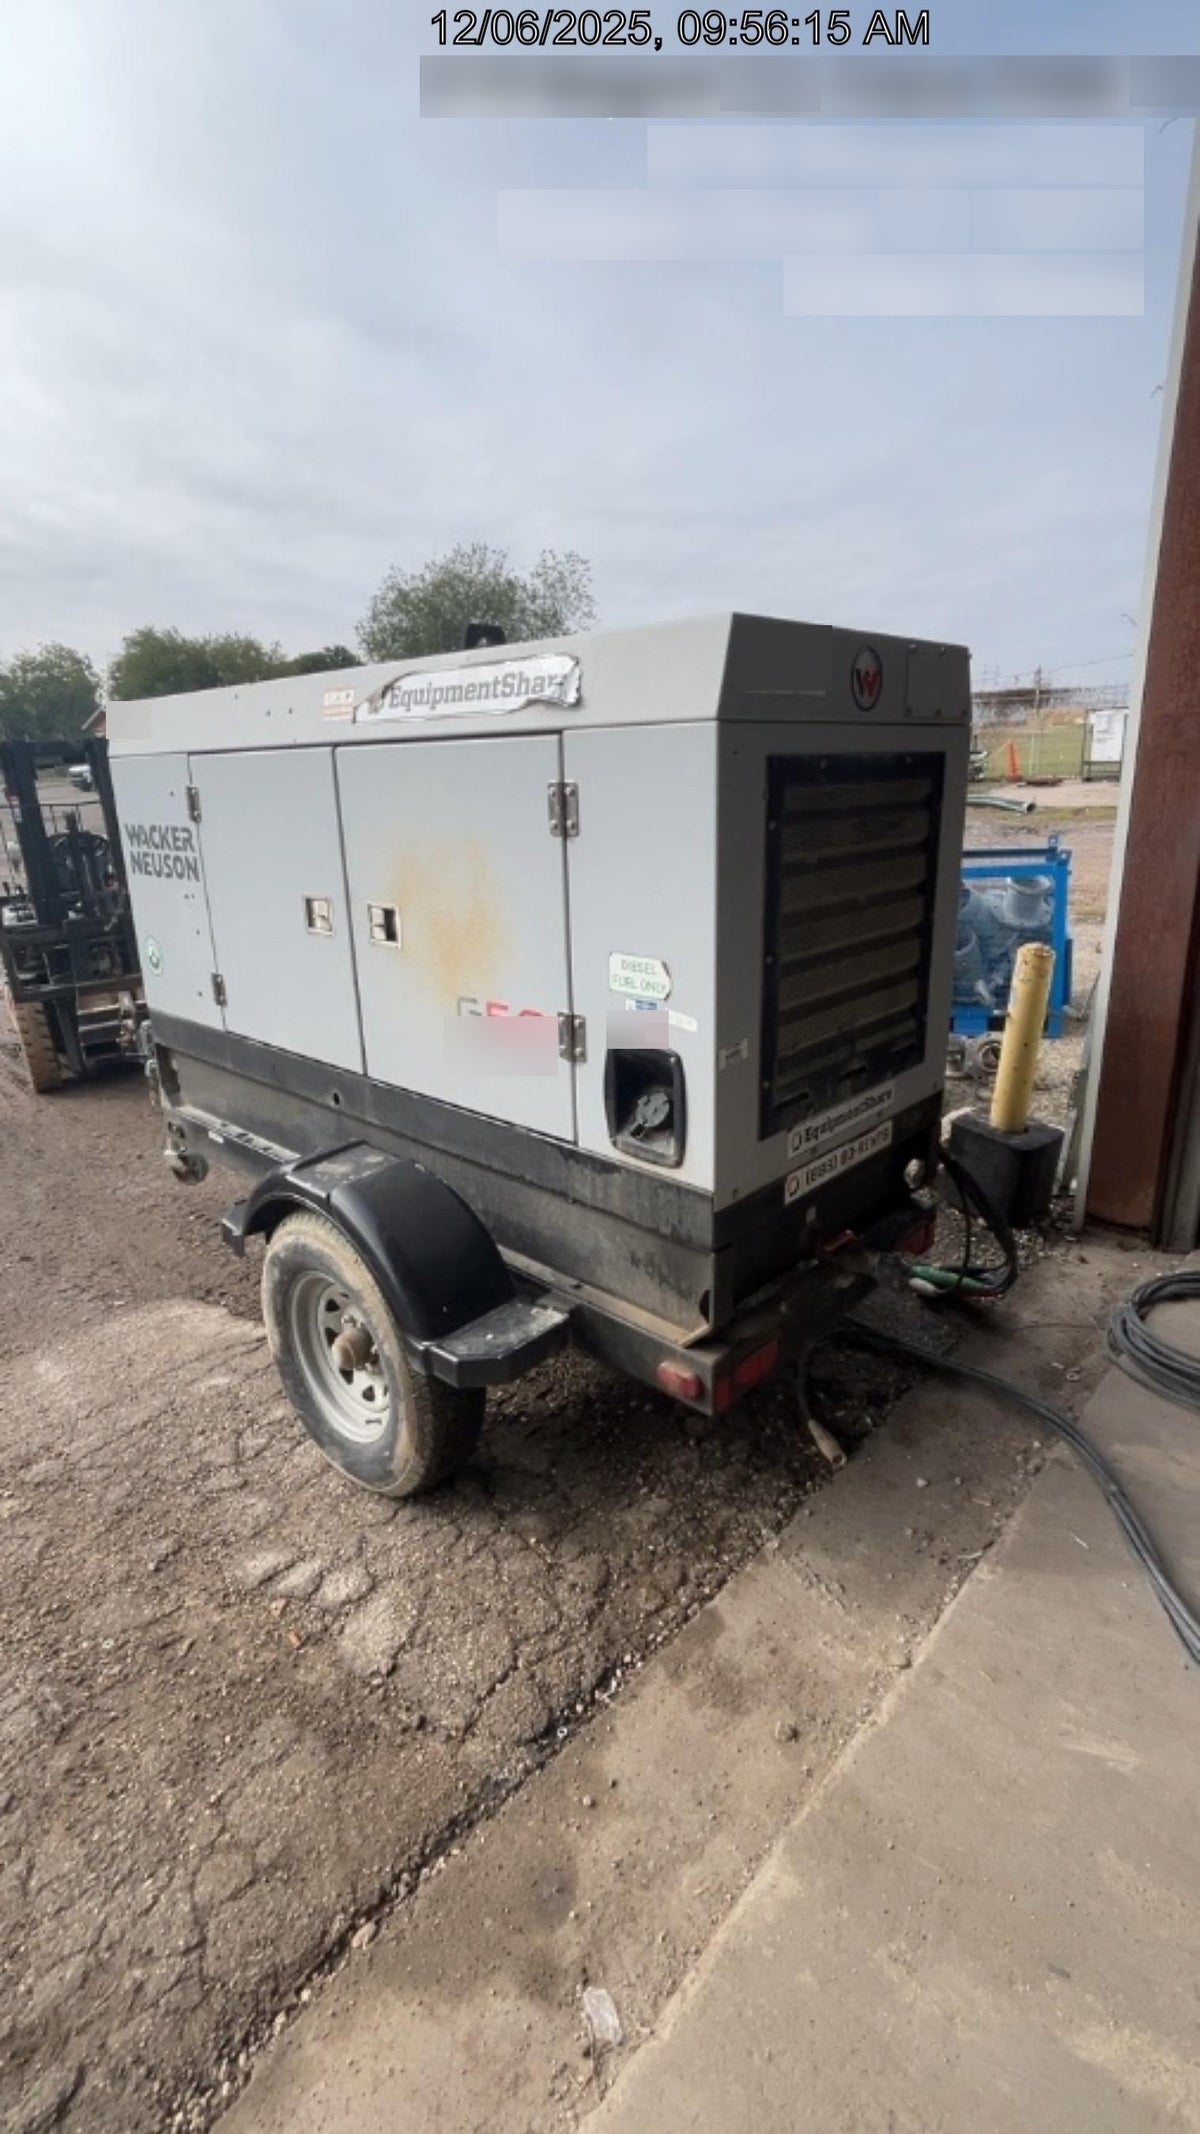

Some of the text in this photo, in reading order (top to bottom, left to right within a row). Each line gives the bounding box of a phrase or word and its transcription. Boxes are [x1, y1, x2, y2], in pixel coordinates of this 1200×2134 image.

[125, 824, 195, 852] WACKER
[130, 851, 200, 882] NEUSON
[621, 959, 657, 975] DIESEL
[613, 974, 666, 993] FUEL ONLY
